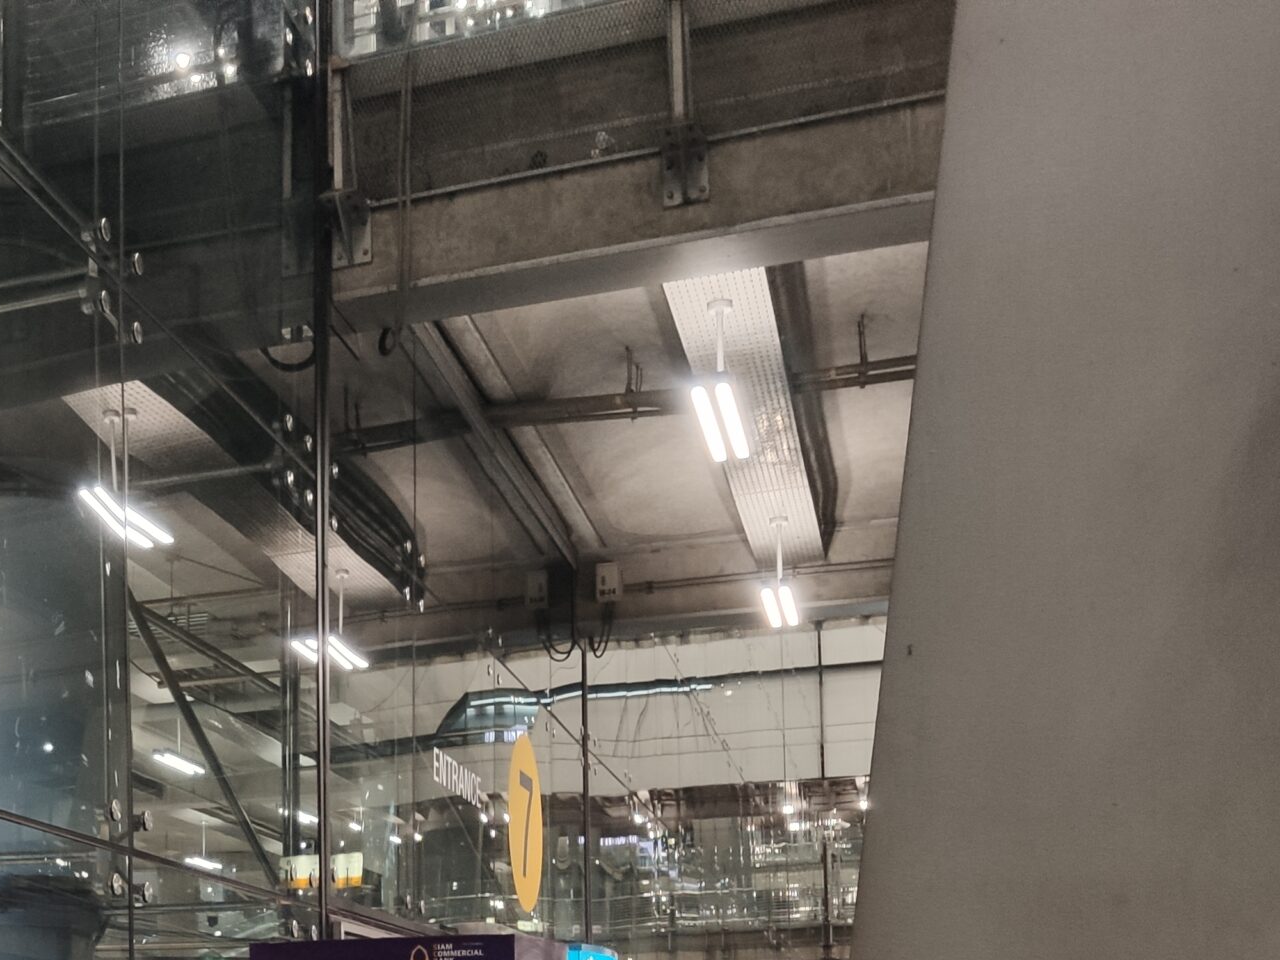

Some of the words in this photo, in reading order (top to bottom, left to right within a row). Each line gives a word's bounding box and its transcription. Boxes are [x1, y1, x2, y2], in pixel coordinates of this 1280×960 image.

[432, 745, 482, 809] ENTRANCE
[519, 768, 533, 879] 7
[432, 943, 453, 951] SIAM
[432, 949, 484, 958] COMMERCIAL
